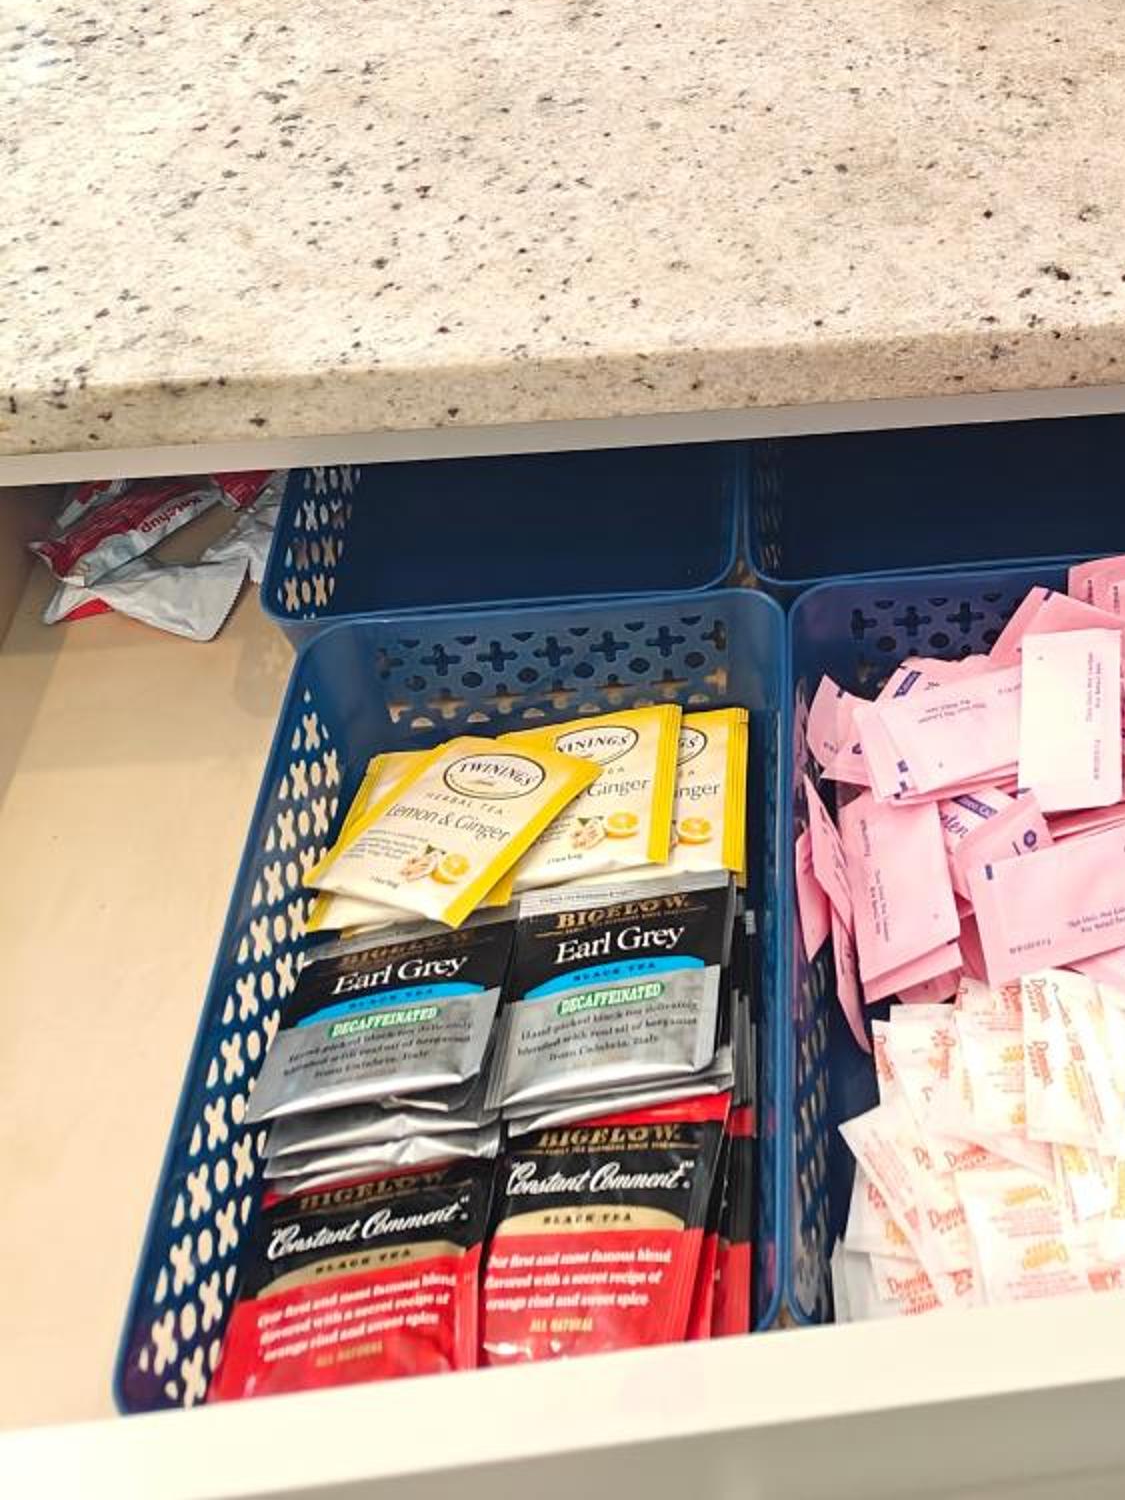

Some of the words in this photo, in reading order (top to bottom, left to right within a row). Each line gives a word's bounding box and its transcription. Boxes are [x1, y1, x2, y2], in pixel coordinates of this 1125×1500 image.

[386, 804, 438, 826] Lemon
[438, 812, 451, 826] &
[455, 814, 511, 842] Ginger
[553, 931, 611, 965] Earl
[617, 926, 685, 950] Grey
[331, 964, 394, 995] Earl
[397, 955, 468, 980] Grey
[560, 982, 662, 1014] DECAFFEINATED
[331, 1007, 438, 1038] DECAFFEINATED
